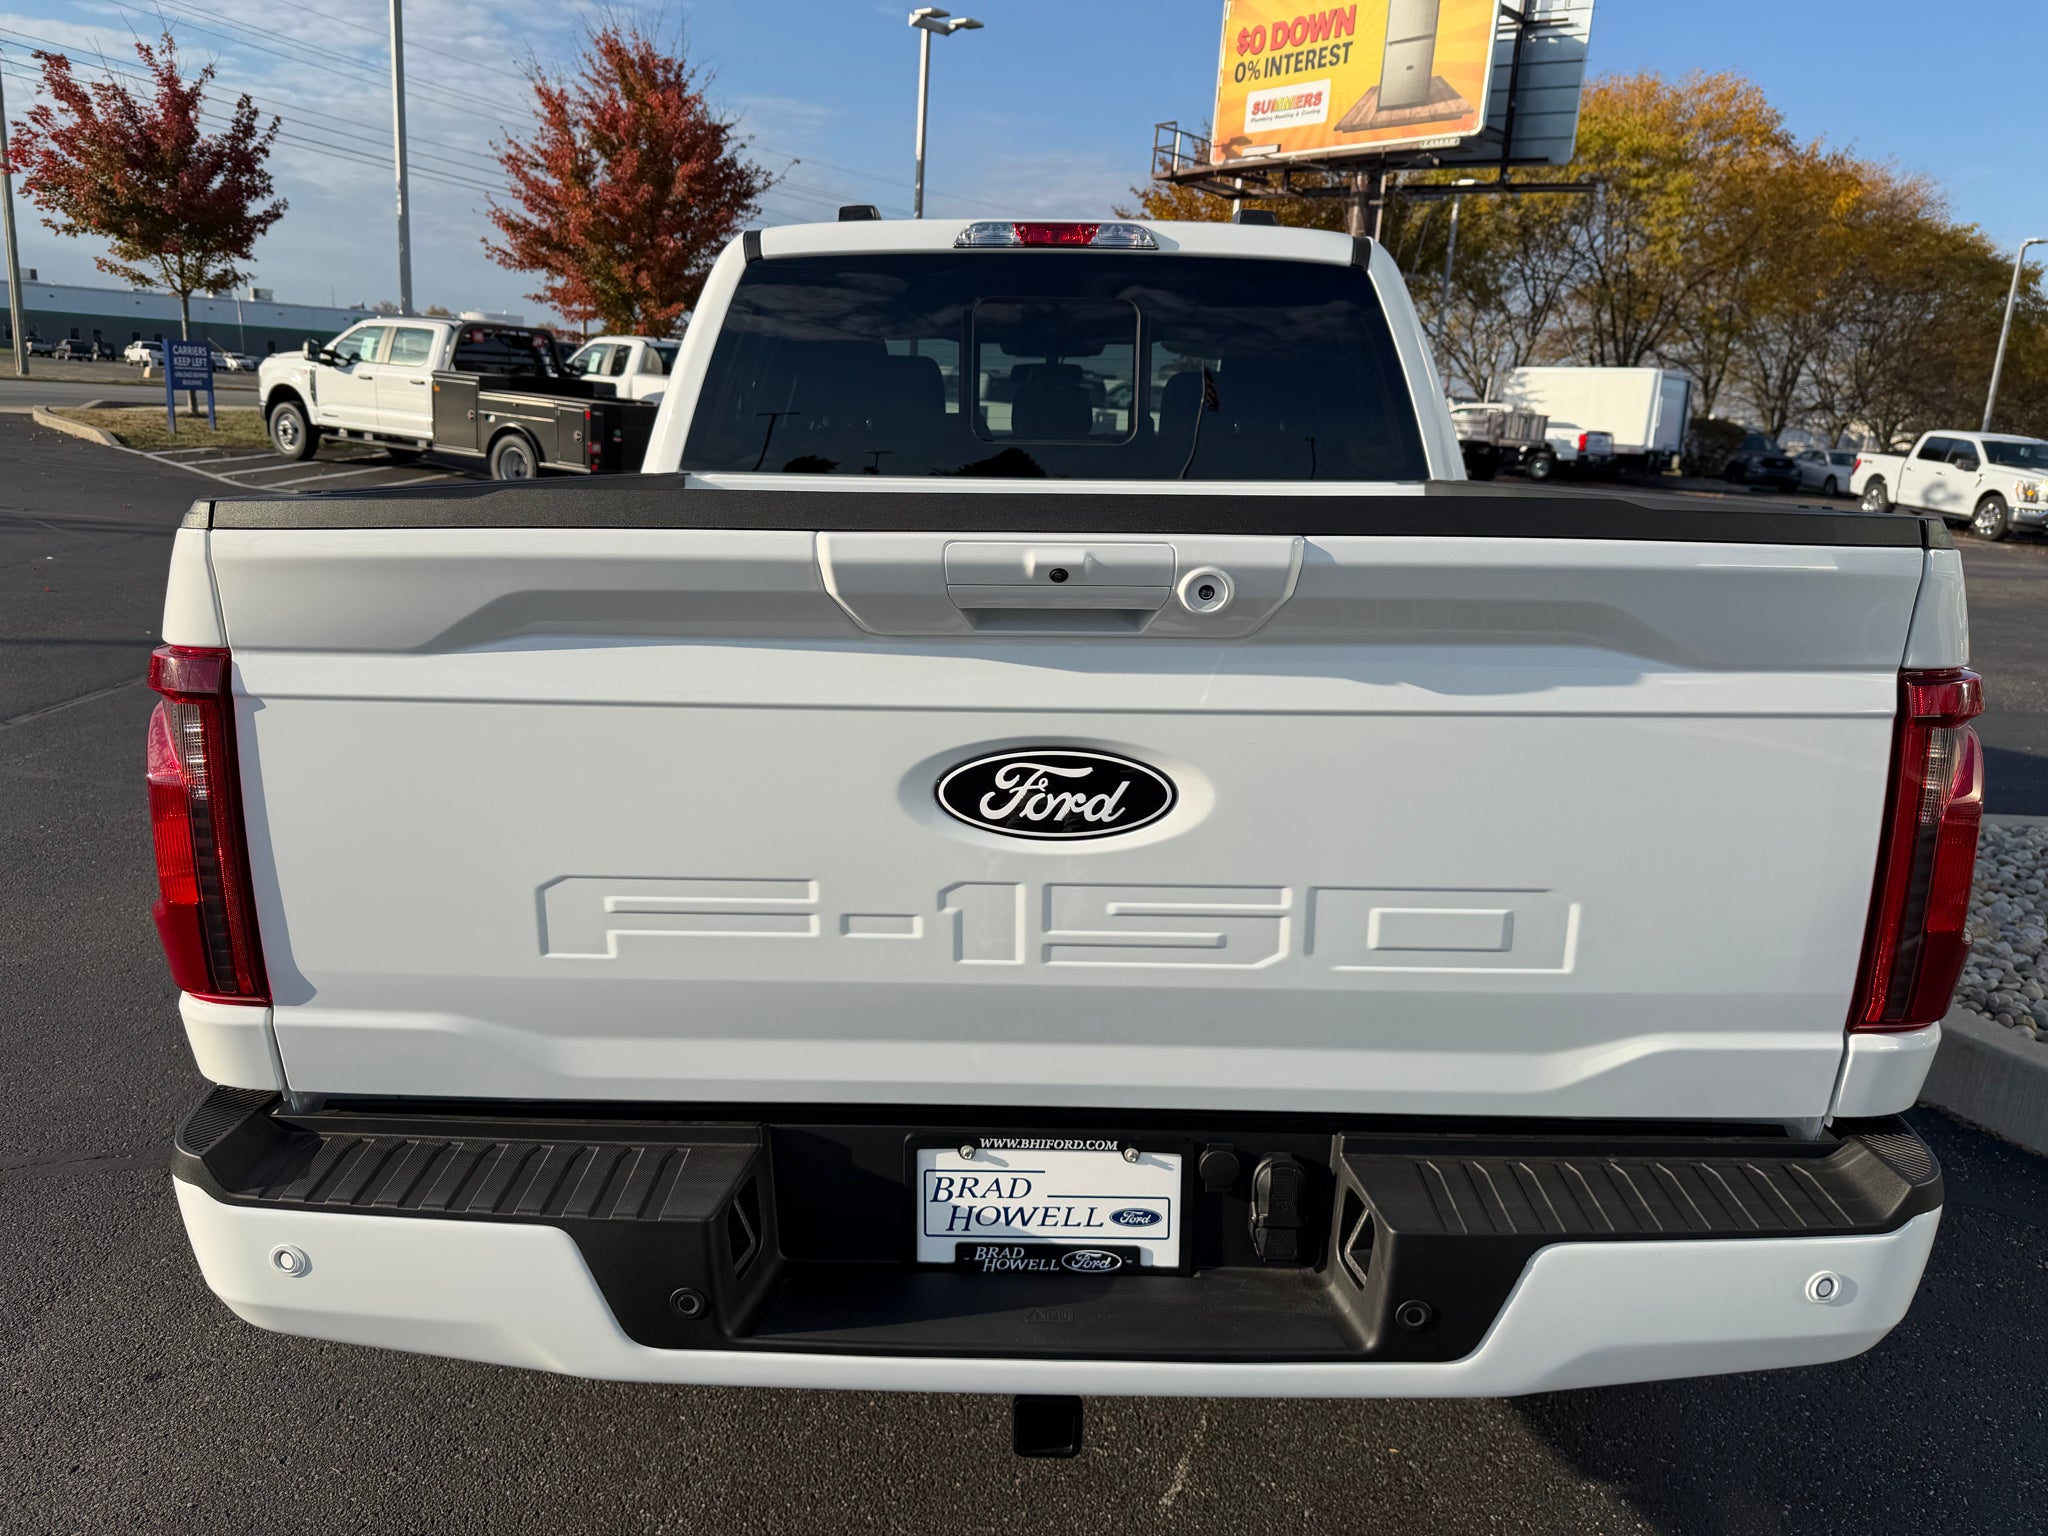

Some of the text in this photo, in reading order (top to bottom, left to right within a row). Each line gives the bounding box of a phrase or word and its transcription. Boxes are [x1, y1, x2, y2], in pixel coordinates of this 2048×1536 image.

[1236, 4, 1357, 57] $0 DOWN
[1234, 41, 1354, 84] 0% INTEREST
[1251, 90, 1323, 116] SUMMERS
[172, 344, 208, 356] CARRIERS
[173, 356, 207, 367] KEEP LEFT
[979, 762, 1131, 823] Ford
[535, 875, 1581, 974] F-150
[979, 1137, 1118, 1151] WWW.BHIFORD.COM
[930, 1176, 1032, 1203] BRAD
[945, 1205, 1152, 1231] HOWELL Ford
[974, 1246, 1025, 1261] BRAD
[983, 1250, 1111, 1273] HOWELL Ford
